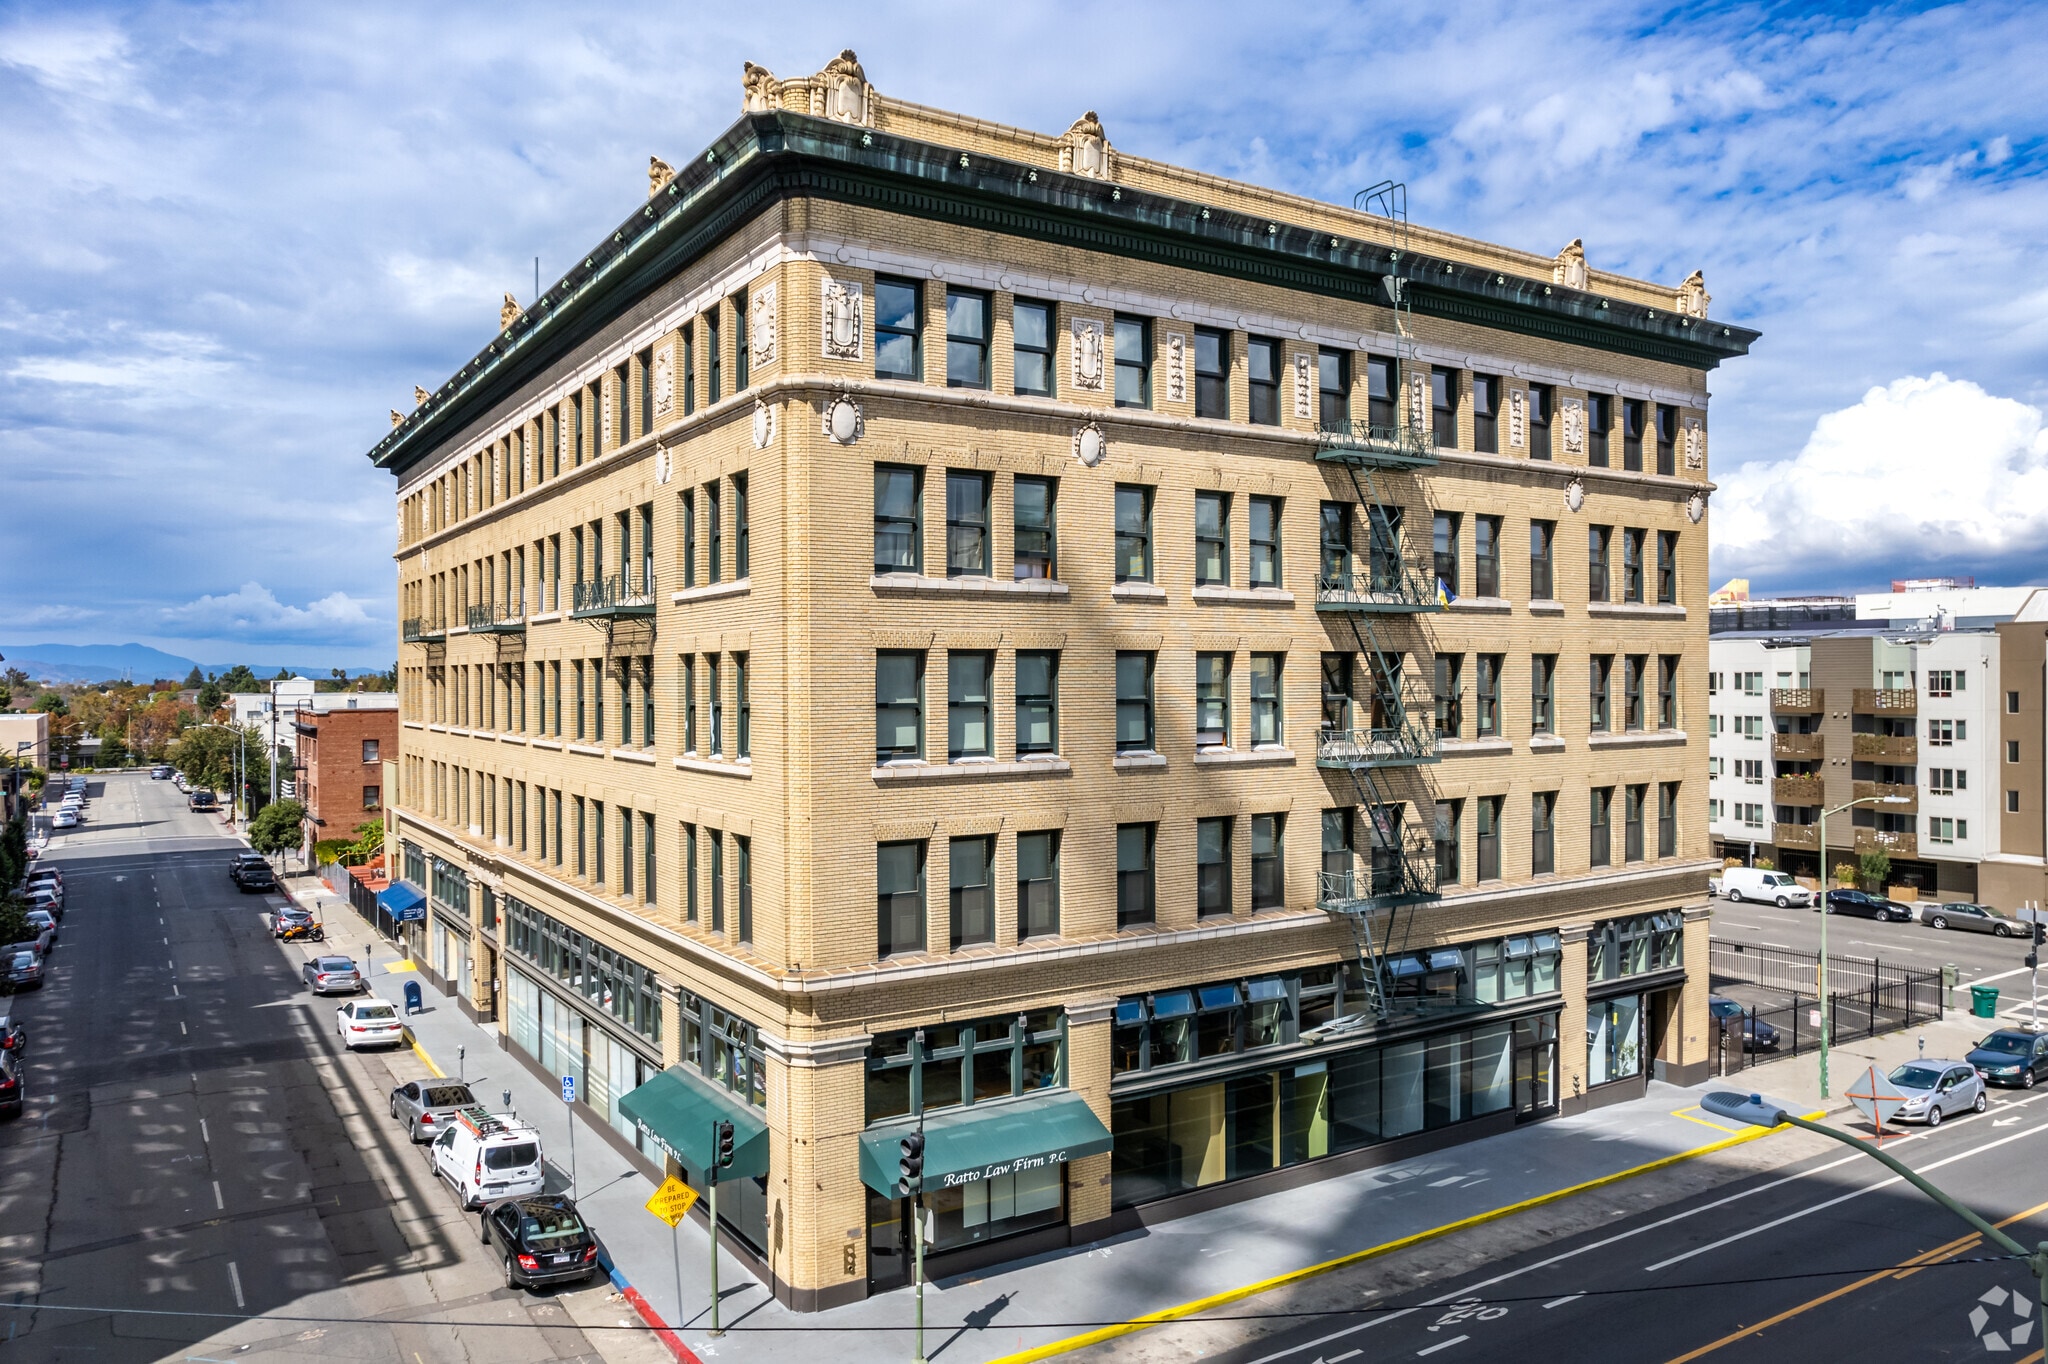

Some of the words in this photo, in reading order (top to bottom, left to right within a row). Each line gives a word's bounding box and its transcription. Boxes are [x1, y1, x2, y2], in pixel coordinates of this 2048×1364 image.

[943, 1171, 980, 1187] Ratto
[983, 1164, 1010, 1180] Law
[1013, 1156, 1045, 1172] Firm
[1048, 1150, 1068, 1165] P.C.
[667, 1184, 676, 1193] BE
[654, 1191, 690, 1205] PREPARED
[660, 1207, 668, 1215] TO
[670, 1202, 686, 1213] STOP
